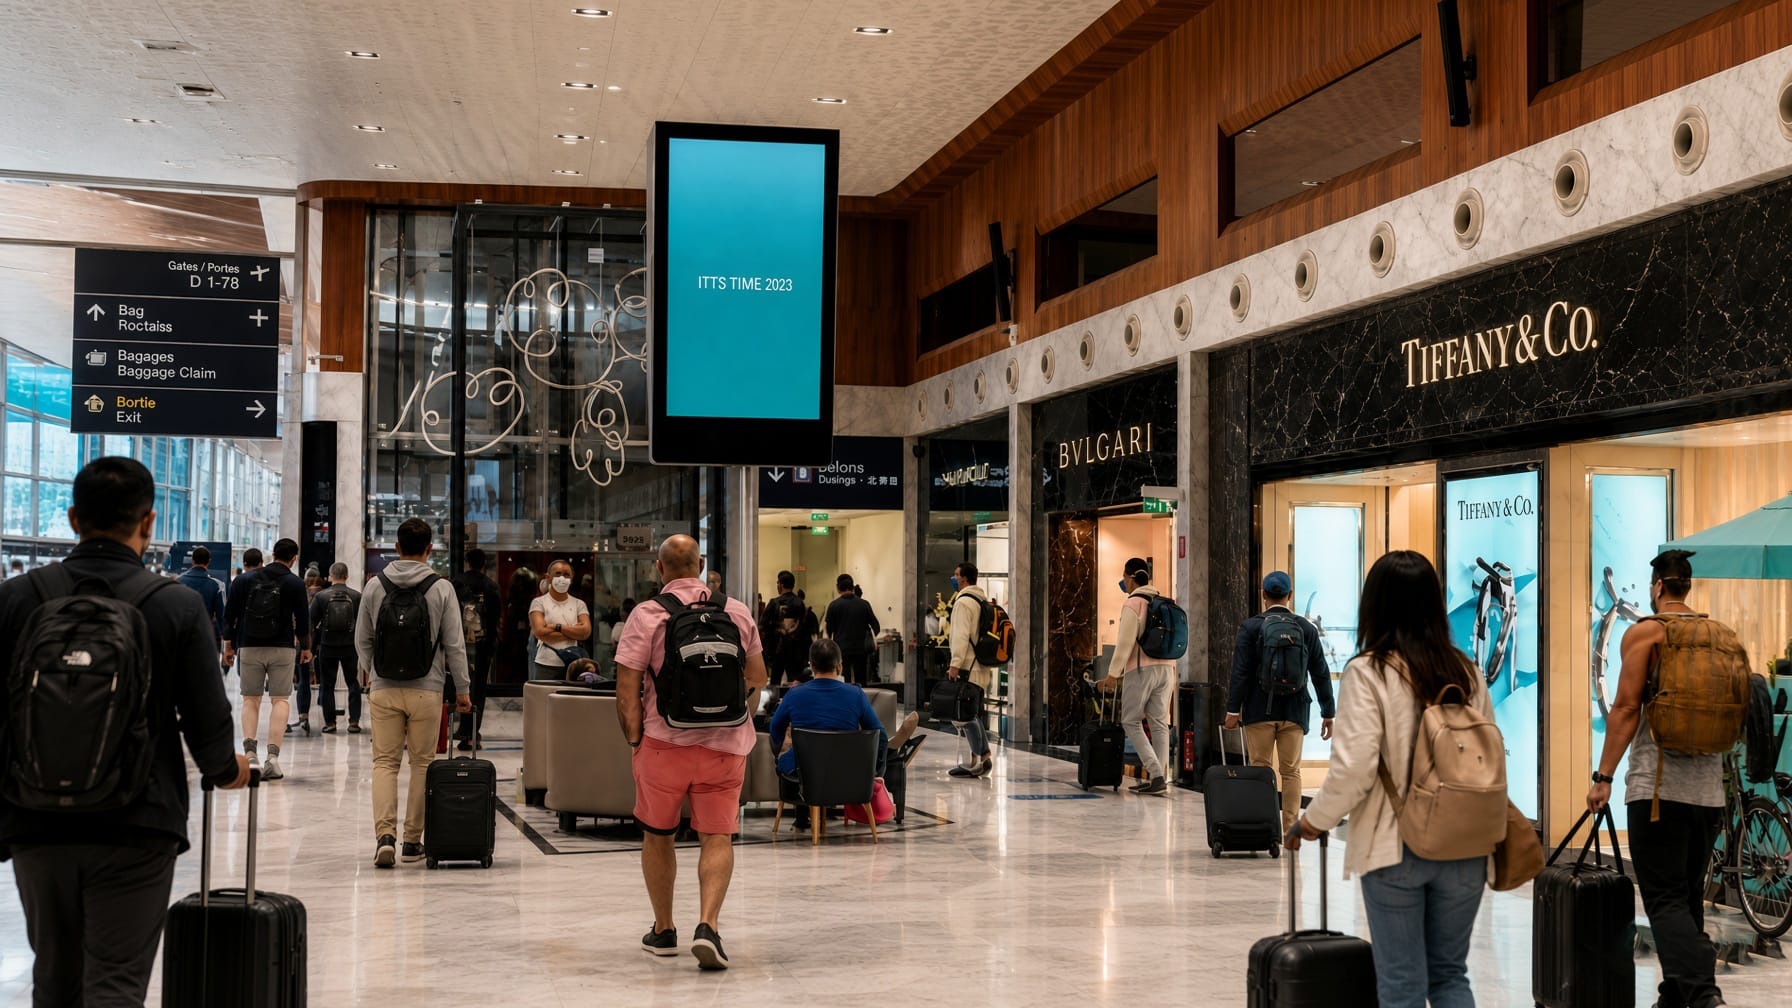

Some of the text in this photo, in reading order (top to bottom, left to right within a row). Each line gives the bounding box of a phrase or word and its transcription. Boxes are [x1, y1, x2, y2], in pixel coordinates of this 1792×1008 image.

[168, 260, 198, 272] Gates
[207, 262, 240, 274] Portes
[190, 275, 240, 290] D 1-78
[699, 275, 793, 292] ITTS TIME 2023
[118, 304, 144, 319] Bag
[118, 319, 173, 333] Roctaiss
[118, 350, 175, 365] Bagages
[117, 365, 216, 380] Baggage Claim
[116, 395, 156, 409] Bortie
[116, 411, 142, 423] Exit
[1059, 423, 1151, 469] BVLGARI
[818, 474, 857, 487] Dusings
[1457, 500, 1502, 521] TIFFANY
[1503, 498, 1513, 517] &
